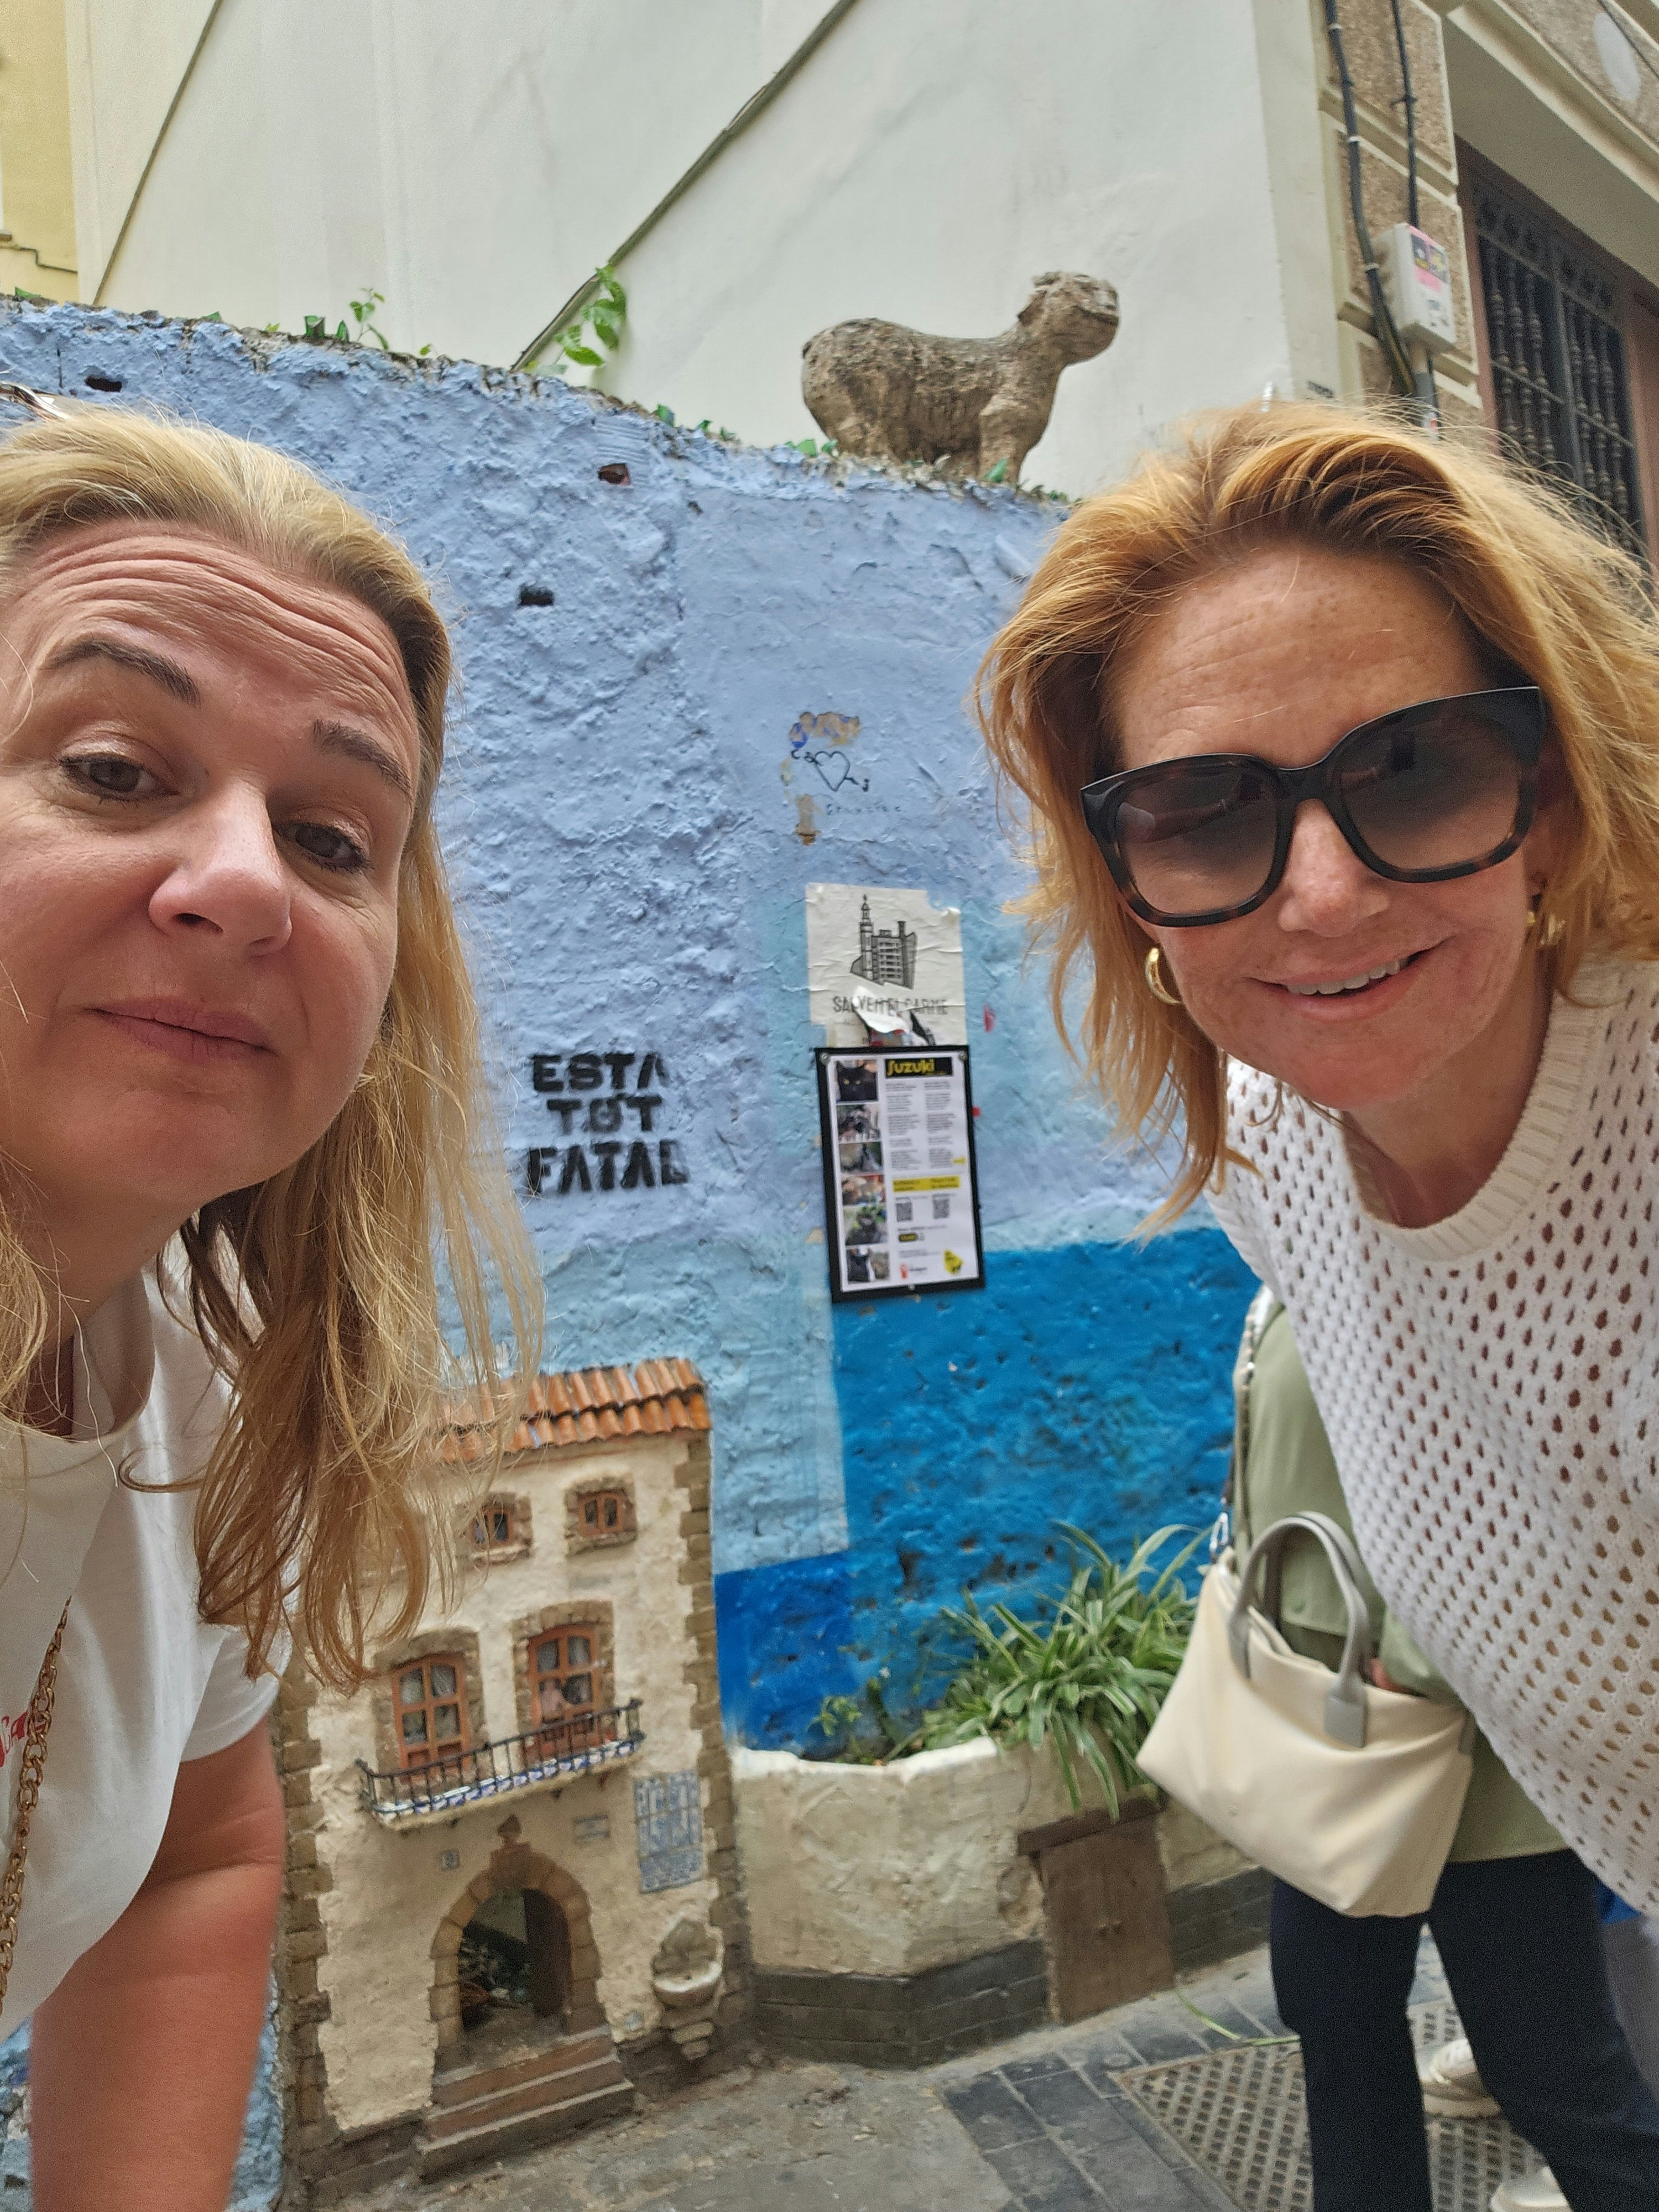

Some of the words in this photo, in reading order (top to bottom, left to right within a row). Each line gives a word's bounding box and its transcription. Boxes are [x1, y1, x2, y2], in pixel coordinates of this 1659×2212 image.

[532, 1052, 670, 1092] ESTA
[546, 1094, 662, 1135] TOT
[527, 1140, 690, 1195] FATAL
